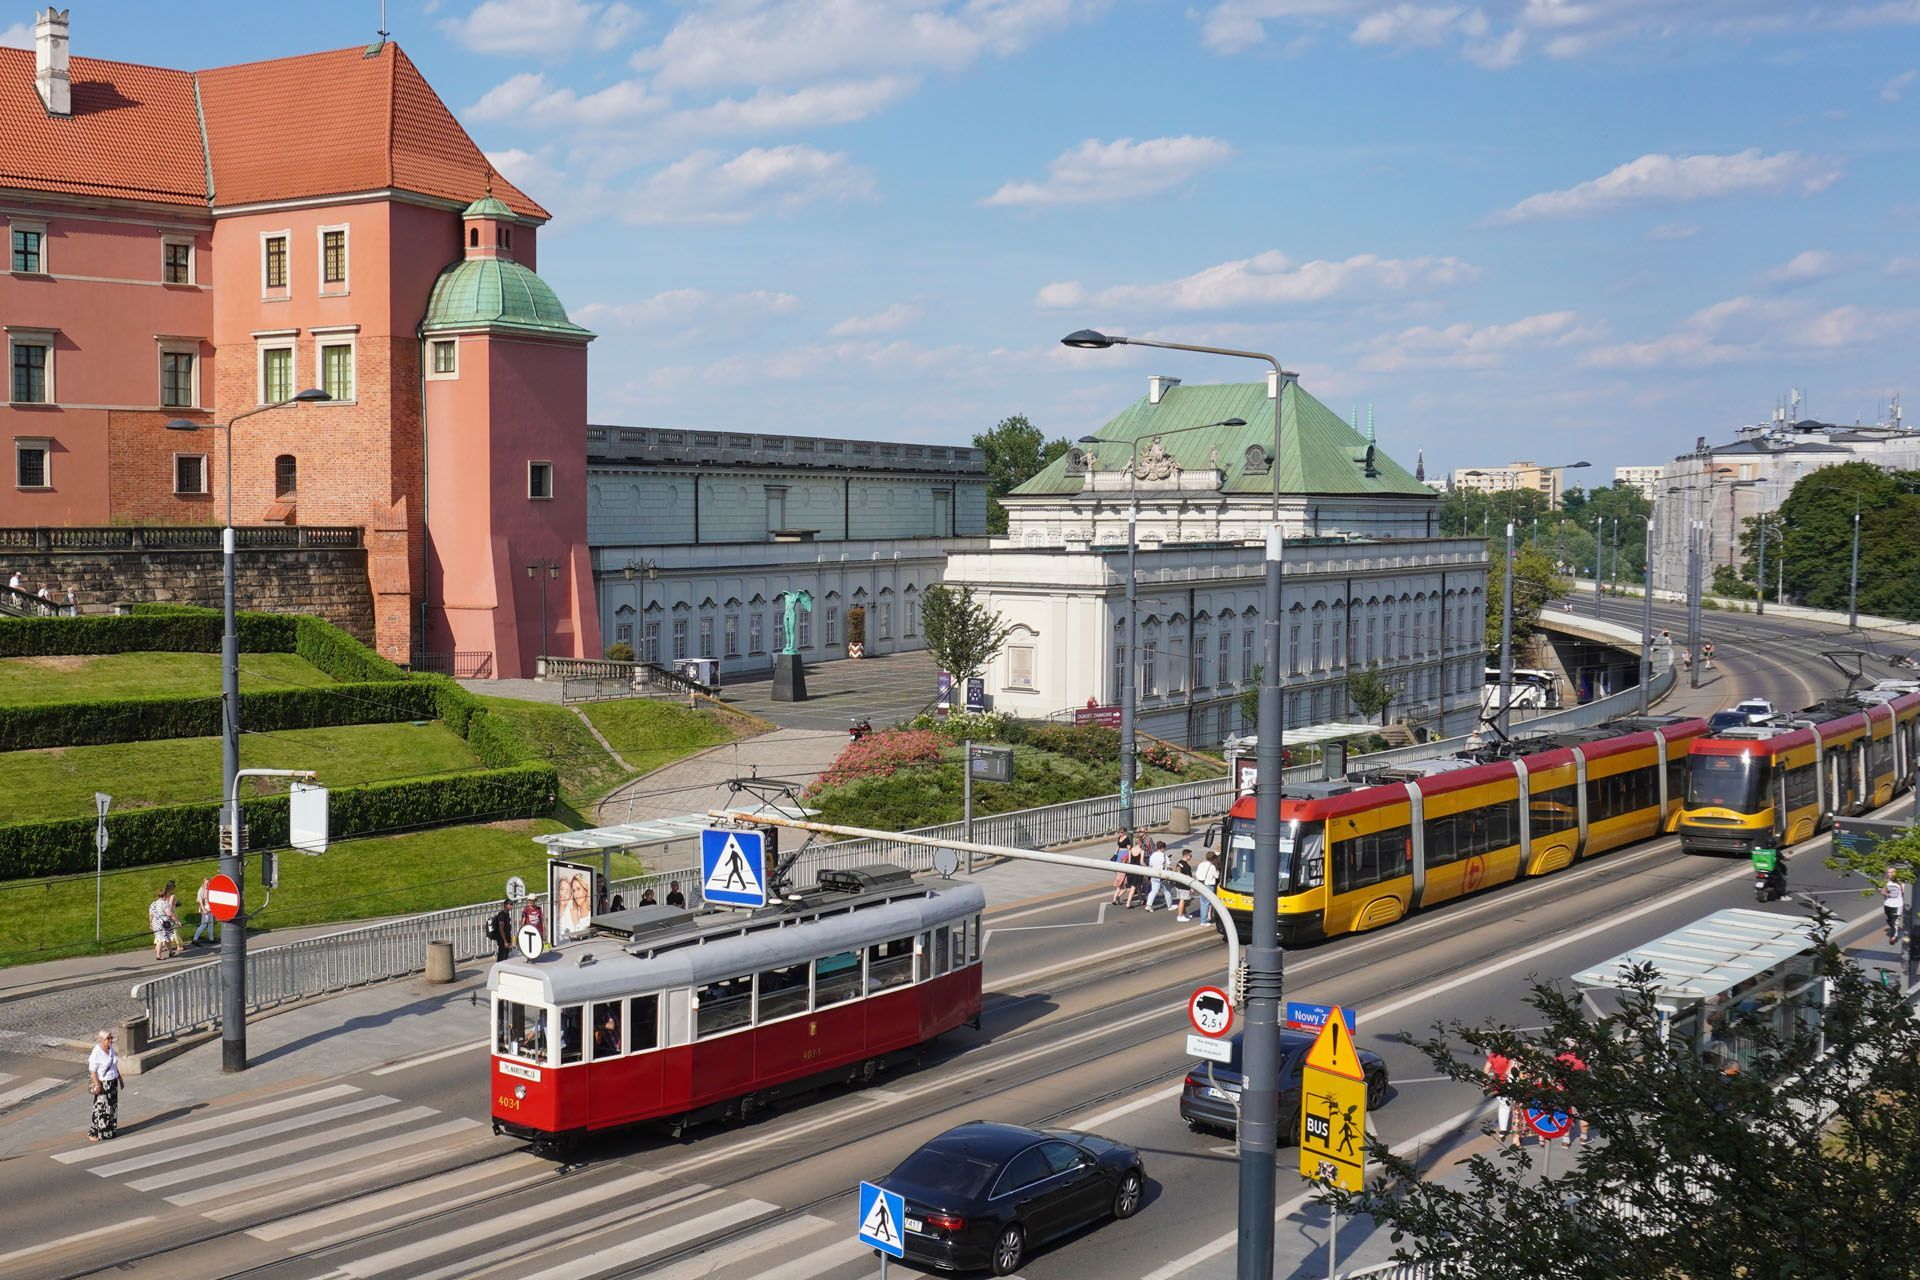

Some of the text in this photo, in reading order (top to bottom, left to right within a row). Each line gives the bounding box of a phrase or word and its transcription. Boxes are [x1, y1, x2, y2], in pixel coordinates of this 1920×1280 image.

[524, 930, 536, 953] T
[1201, 1014, 1217, 1028] 2,5
[1294, 1009, 1319, 1025] Nowy
[1306, 1117, 1329, 1137] BUS
